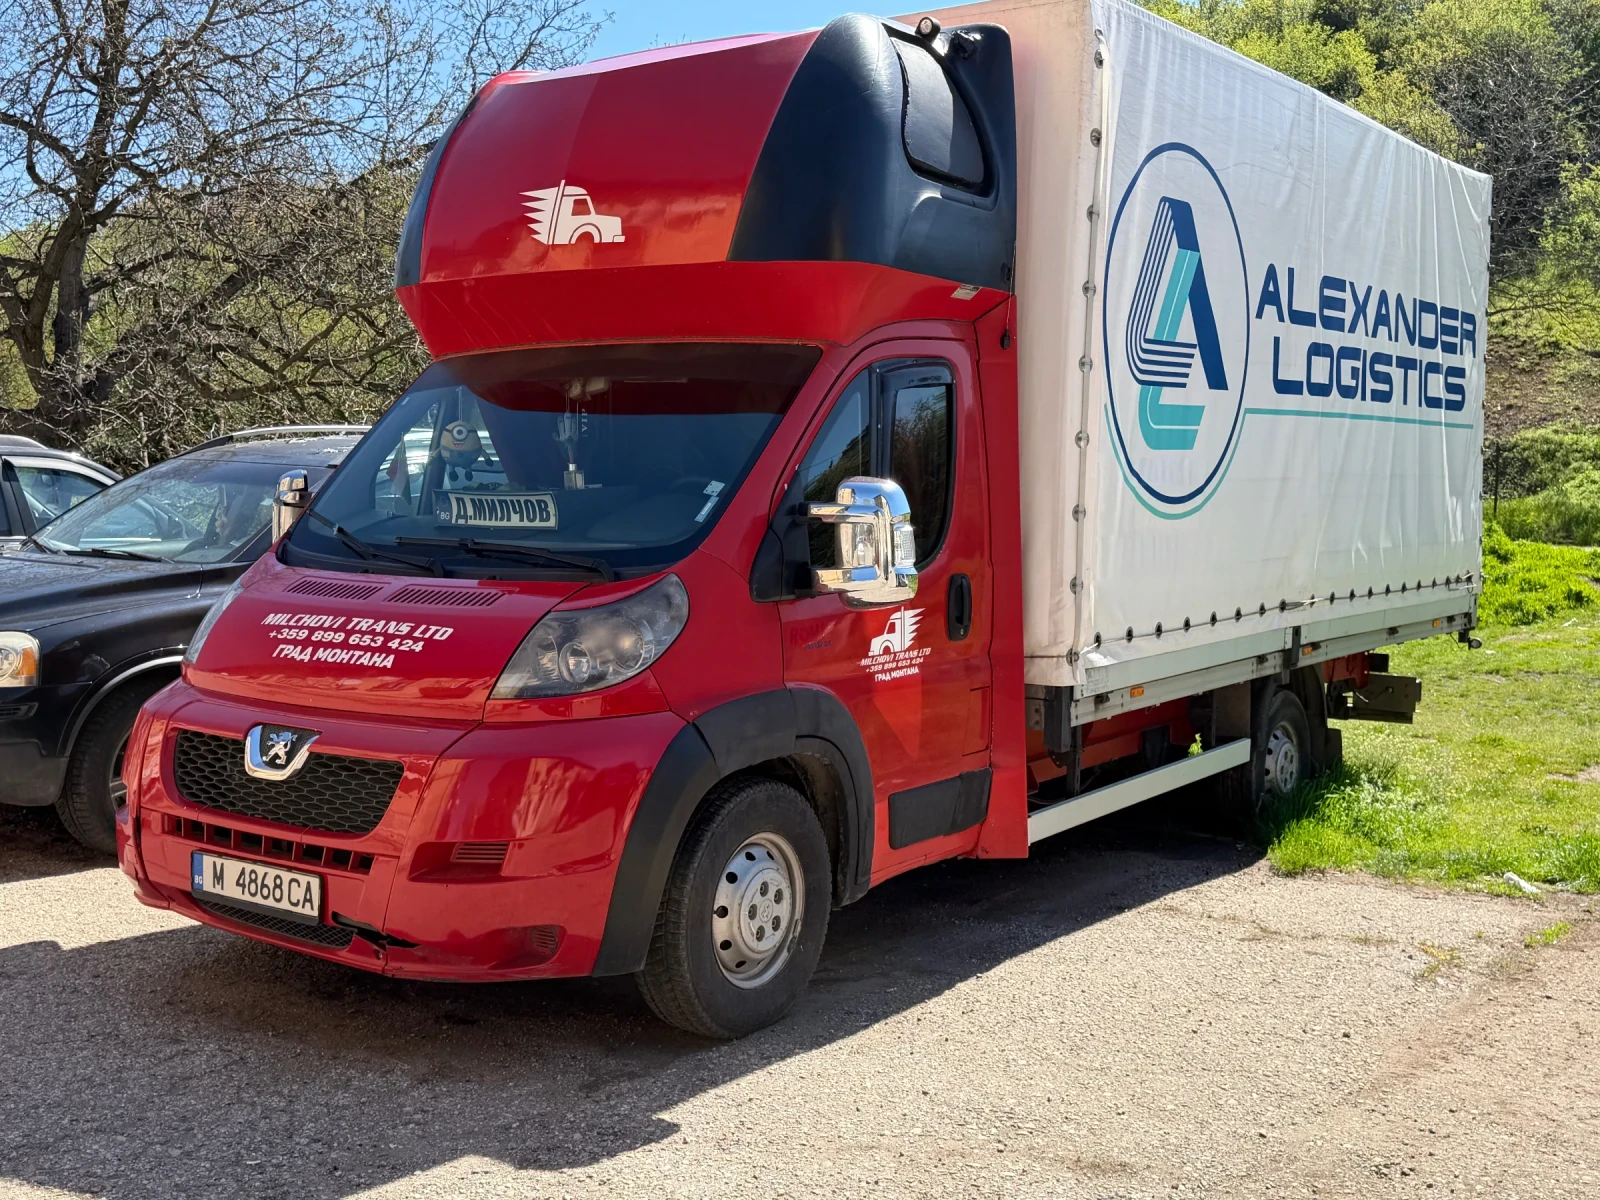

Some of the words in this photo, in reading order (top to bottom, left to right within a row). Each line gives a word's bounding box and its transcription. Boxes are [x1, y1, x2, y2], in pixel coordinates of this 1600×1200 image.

[1255, 263, 1477, 358] ALEXANDER
[1272, 336, 1466, 412] LOGISTICS
[440, 511, 450, 520] BG
[455, 496, 551, 524] Д.МИЛЧОВ
[261, 613, 347, 629] MILCHOVI
[346, 617, 415, 635] TRANS
[412, 624, 454, 640] LTD
[268, 628, 309, 640] +359
[311, 630, 345, 643] 899
[349, 633, 384, 647] 653
[387, 638, 425, 653] 424
[272, 644, 312, 662] ГРАД
[312, 647, 396, 669] МОНТАНА
[860, 653, 894, 667] MILCHOVI
[895, 649, 919, 661] TRANS
[919, 647, 931, 656] LTD
[866, 664, 882, 673] +359
[883, 661, 896, 670] 899
[874, 671, 891, 682] ГРАД
[891, 665, 919, 679] МОНТАНА
[194, 874, 203, 884] BG
[212, 860, 225, 891] M
